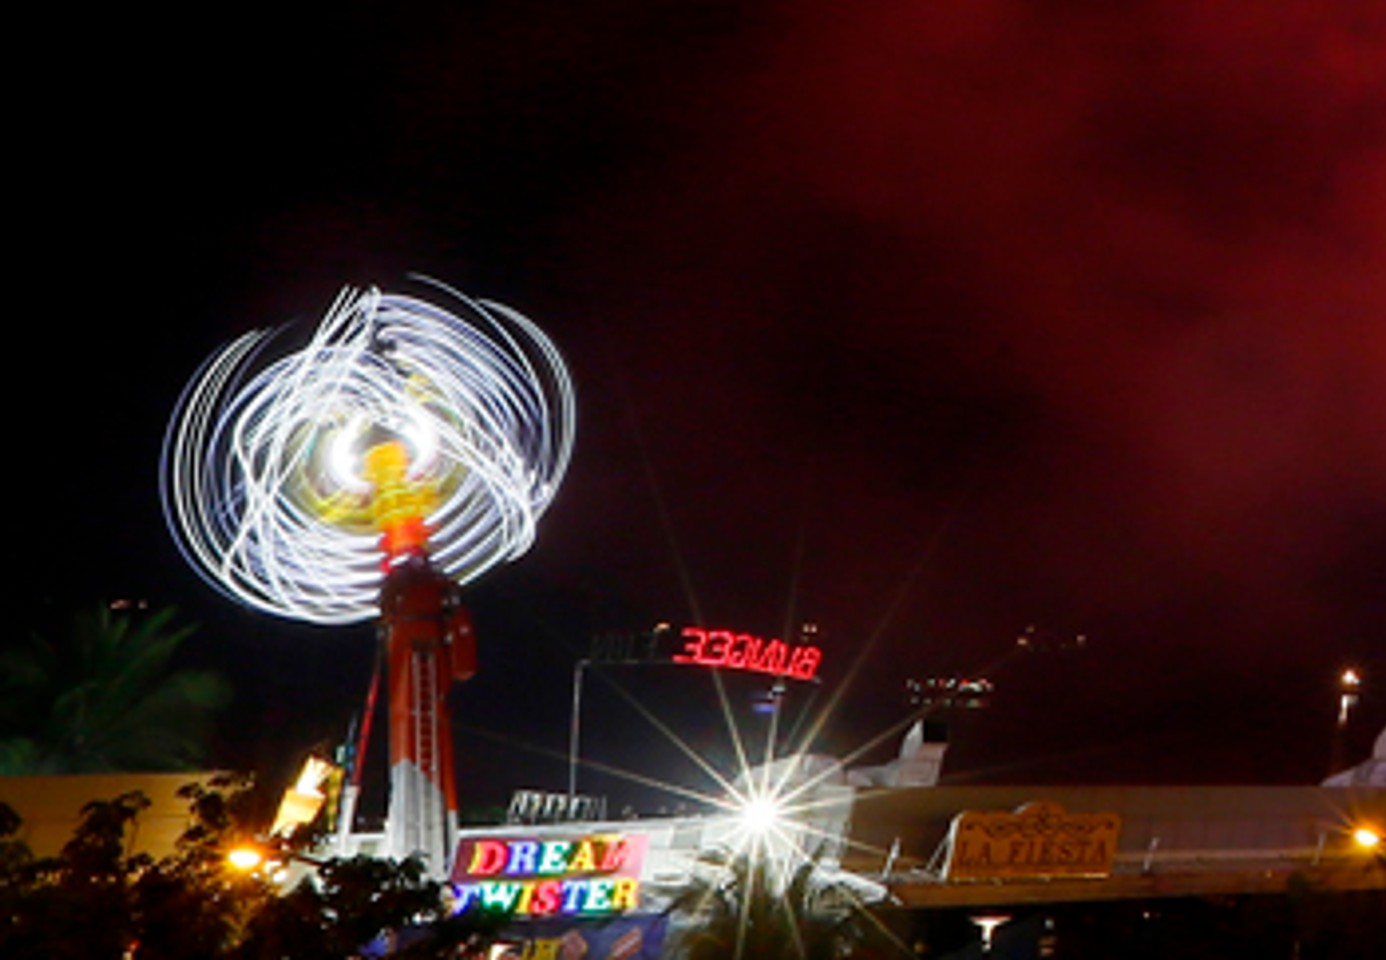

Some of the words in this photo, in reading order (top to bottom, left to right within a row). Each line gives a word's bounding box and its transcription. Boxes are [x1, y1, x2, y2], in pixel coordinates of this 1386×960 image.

[467, 837, 630, 875] DREAM
[1004, 839, 1107, 865] FIESTA
[453, 879, 640, 915] TWISTER
